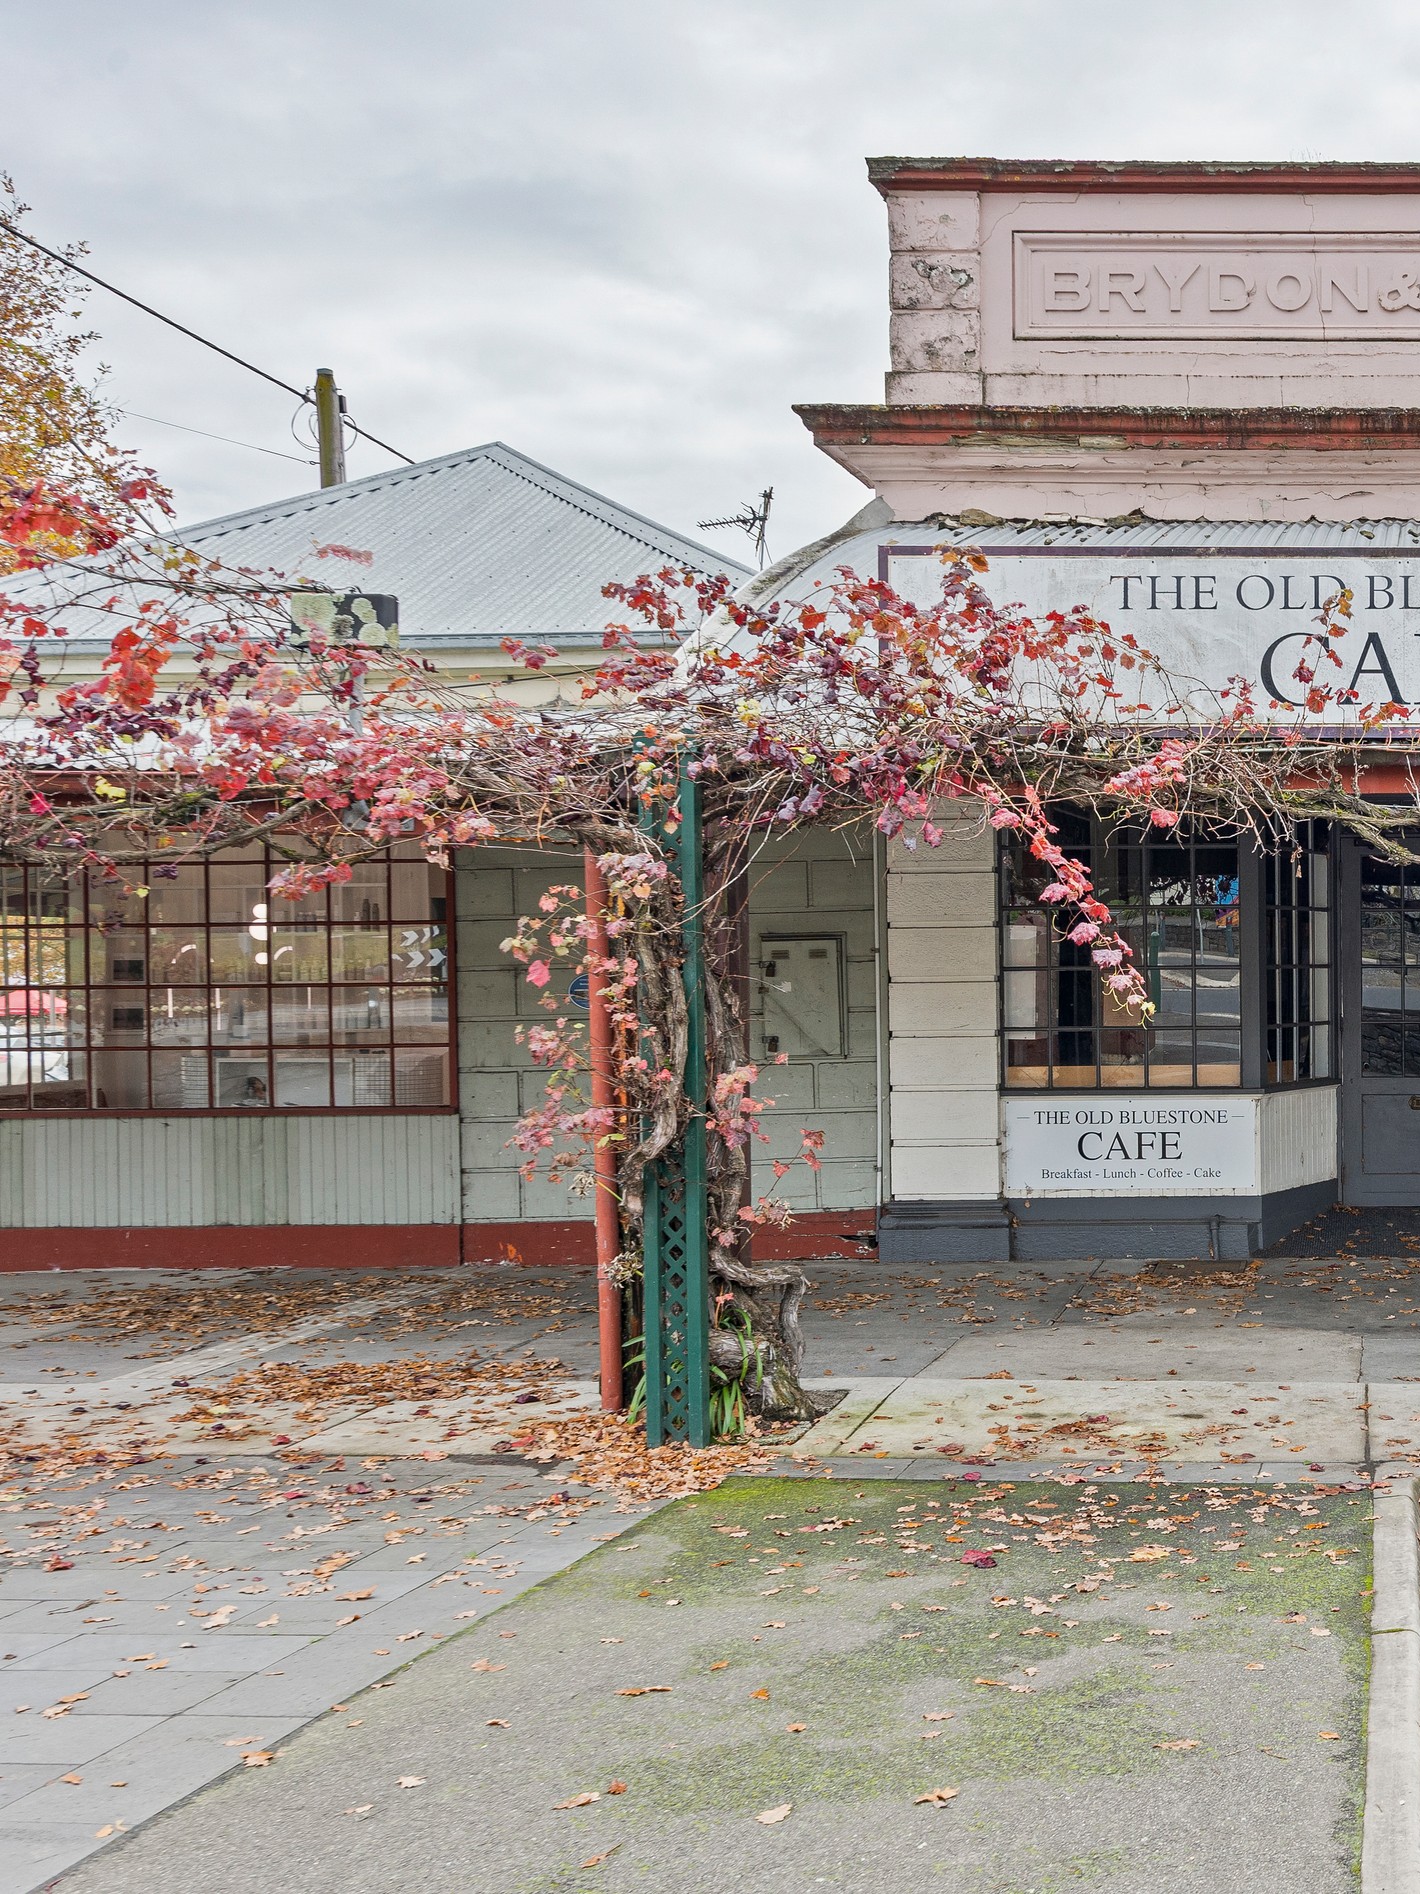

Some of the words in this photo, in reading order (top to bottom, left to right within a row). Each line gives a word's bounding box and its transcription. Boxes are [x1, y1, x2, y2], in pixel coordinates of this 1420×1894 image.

[1109, 574, 1219, 612] THE
[1235, 574, 1349, 612] OLD
[1034, 1110, 1070, 1125] THE
[1075, 1110, 1114, 1125] OLD
[1119, 1109, 1228, 1125] BLUESTONE
[1077, 1131, 1183, 1160] CAFE
[1041, 1168, 1092, 1179] Breakfast
[1103, 1168, 1137, 1179] Lunch
[1147, 1168, 1184, 1179] Coffee
[1194, 1168, 1222, 1179] Cake
